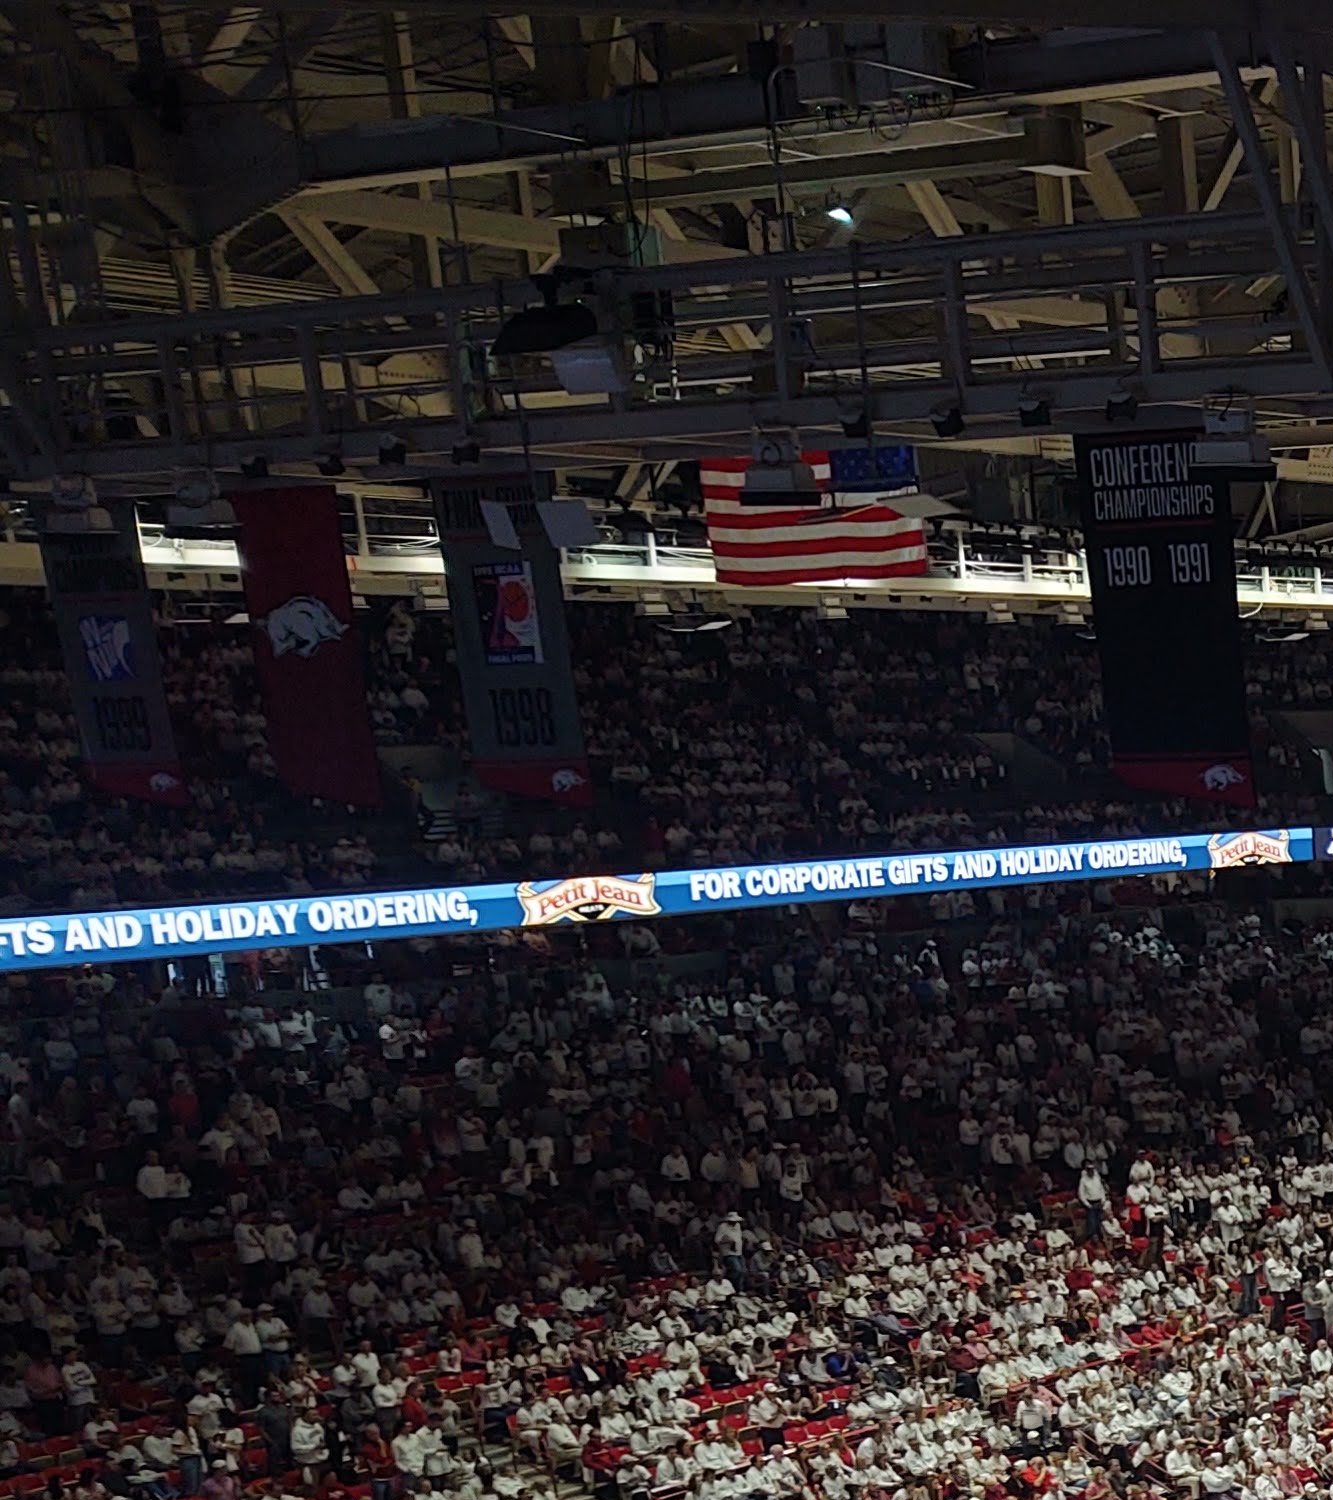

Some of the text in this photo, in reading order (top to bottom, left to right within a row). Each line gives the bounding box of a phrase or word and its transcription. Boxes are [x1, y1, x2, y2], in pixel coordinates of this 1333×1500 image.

[1089, 443, 1196, 487] CONFEREN
[1093, 484, 1215, 521] CHAMPIONSHIPS
[1103, 542, 1212, 587] 1990 1991
[690, 839, 1188, 902] FOR CORPORATE GIFTS AND HOLIDAY ORDERING,
[1220, 835, 1282, 864] Petit Jean
[537, 878, 642, 919] Petit Jean
[64, 890, 479, 952] AND HOLIDAY ORDERING,
